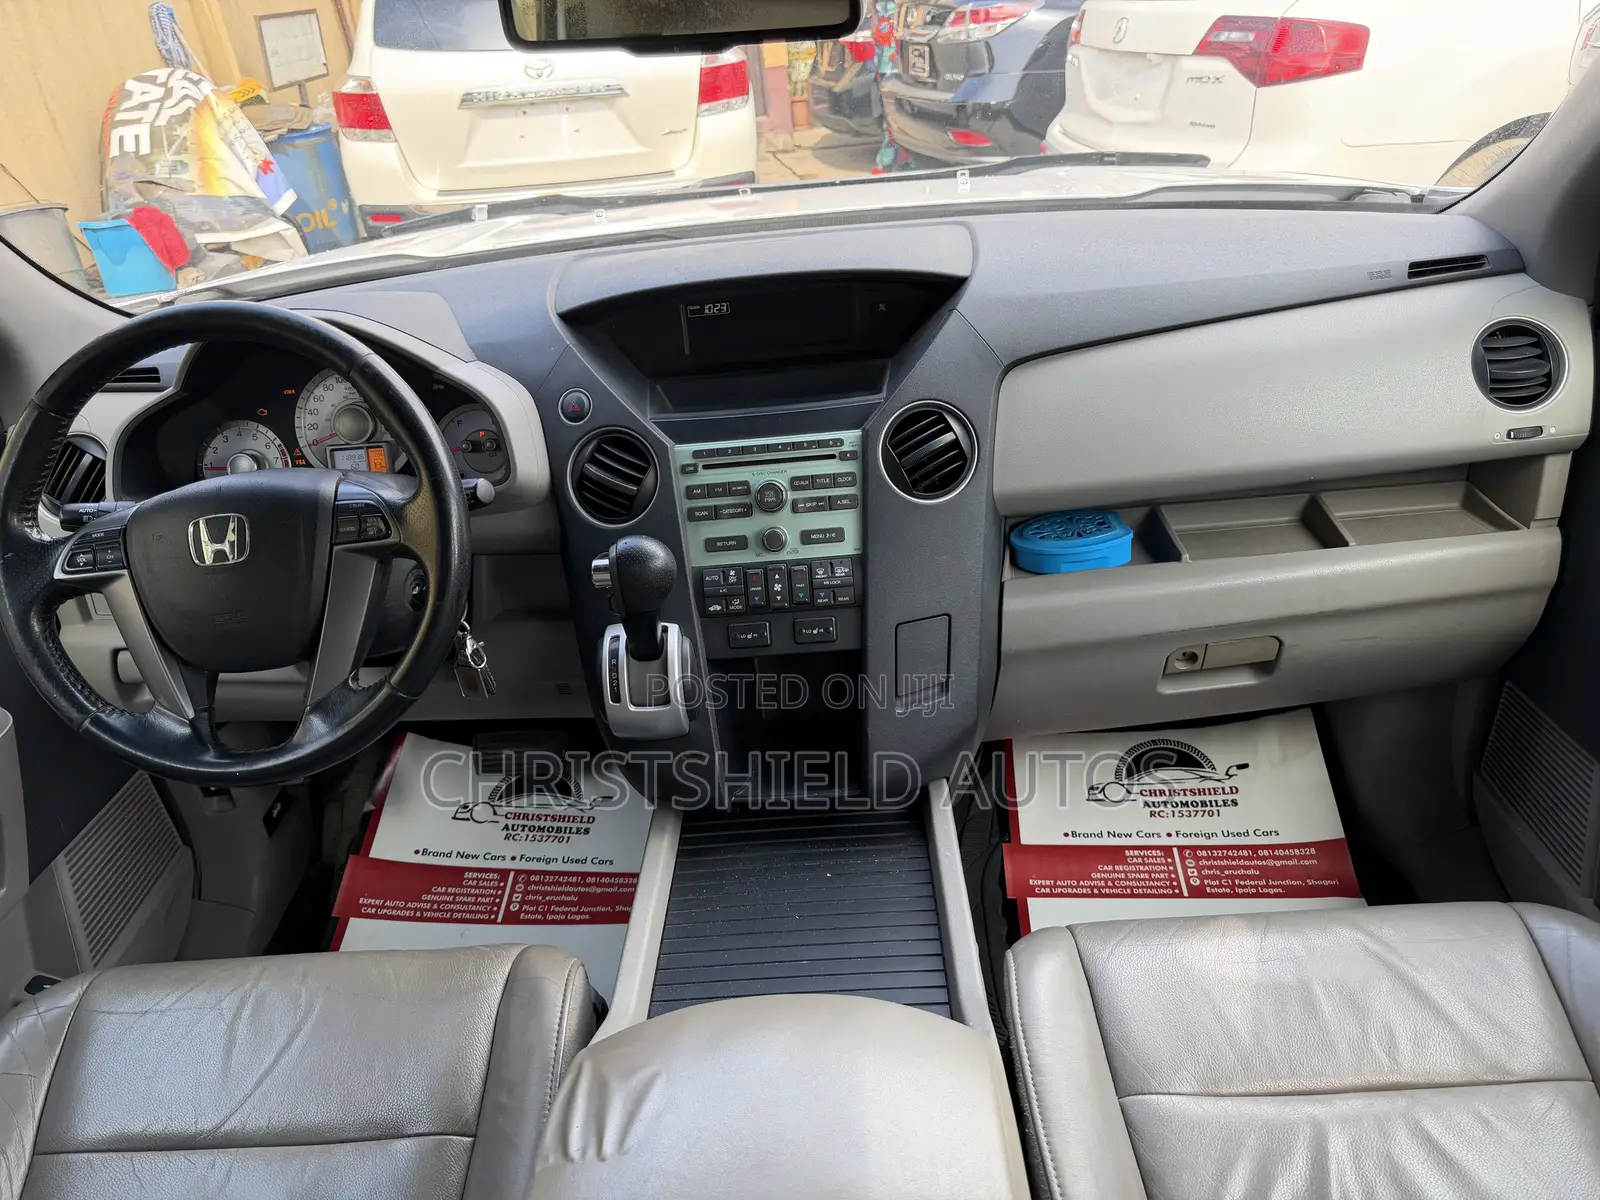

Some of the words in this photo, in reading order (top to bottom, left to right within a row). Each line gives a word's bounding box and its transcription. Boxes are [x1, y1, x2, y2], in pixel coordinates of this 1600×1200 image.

[296, 208, 337, 233] OIL
[1140, 786, 1239, 796] CHRISTSHIELD
[1143, 798, 1238, 808] AUTOMOBILES
[504, 812, 596, 824] CHRISTSHIELD
[1150, 809, 1221, 818] RC:1537701
[501, 824, 590, 835] AUTOMOBILES
[1071, 830, 1103, 839] Brand
[1136, 830, 1161, 838] Cars
[1175, 830, 1218, 840] Foreign
[1221, 829, 1250, 838] Used
[1253, 829, 1279, 837] Cars
[504, 833, 571, 844] RC:1537701
[421, 848, 452, 859] Brand
[456, 851, 480, 860] New
[483, 852, 506, 862] Cars
[519, 854, 558, 864] Foreign
[561, 856, 588, 865] Used
[590, 857, 614, 866] Cars
[530, 875, 584, 883] 08132742481,
[377, 908, 414, 916] UPGRADES
